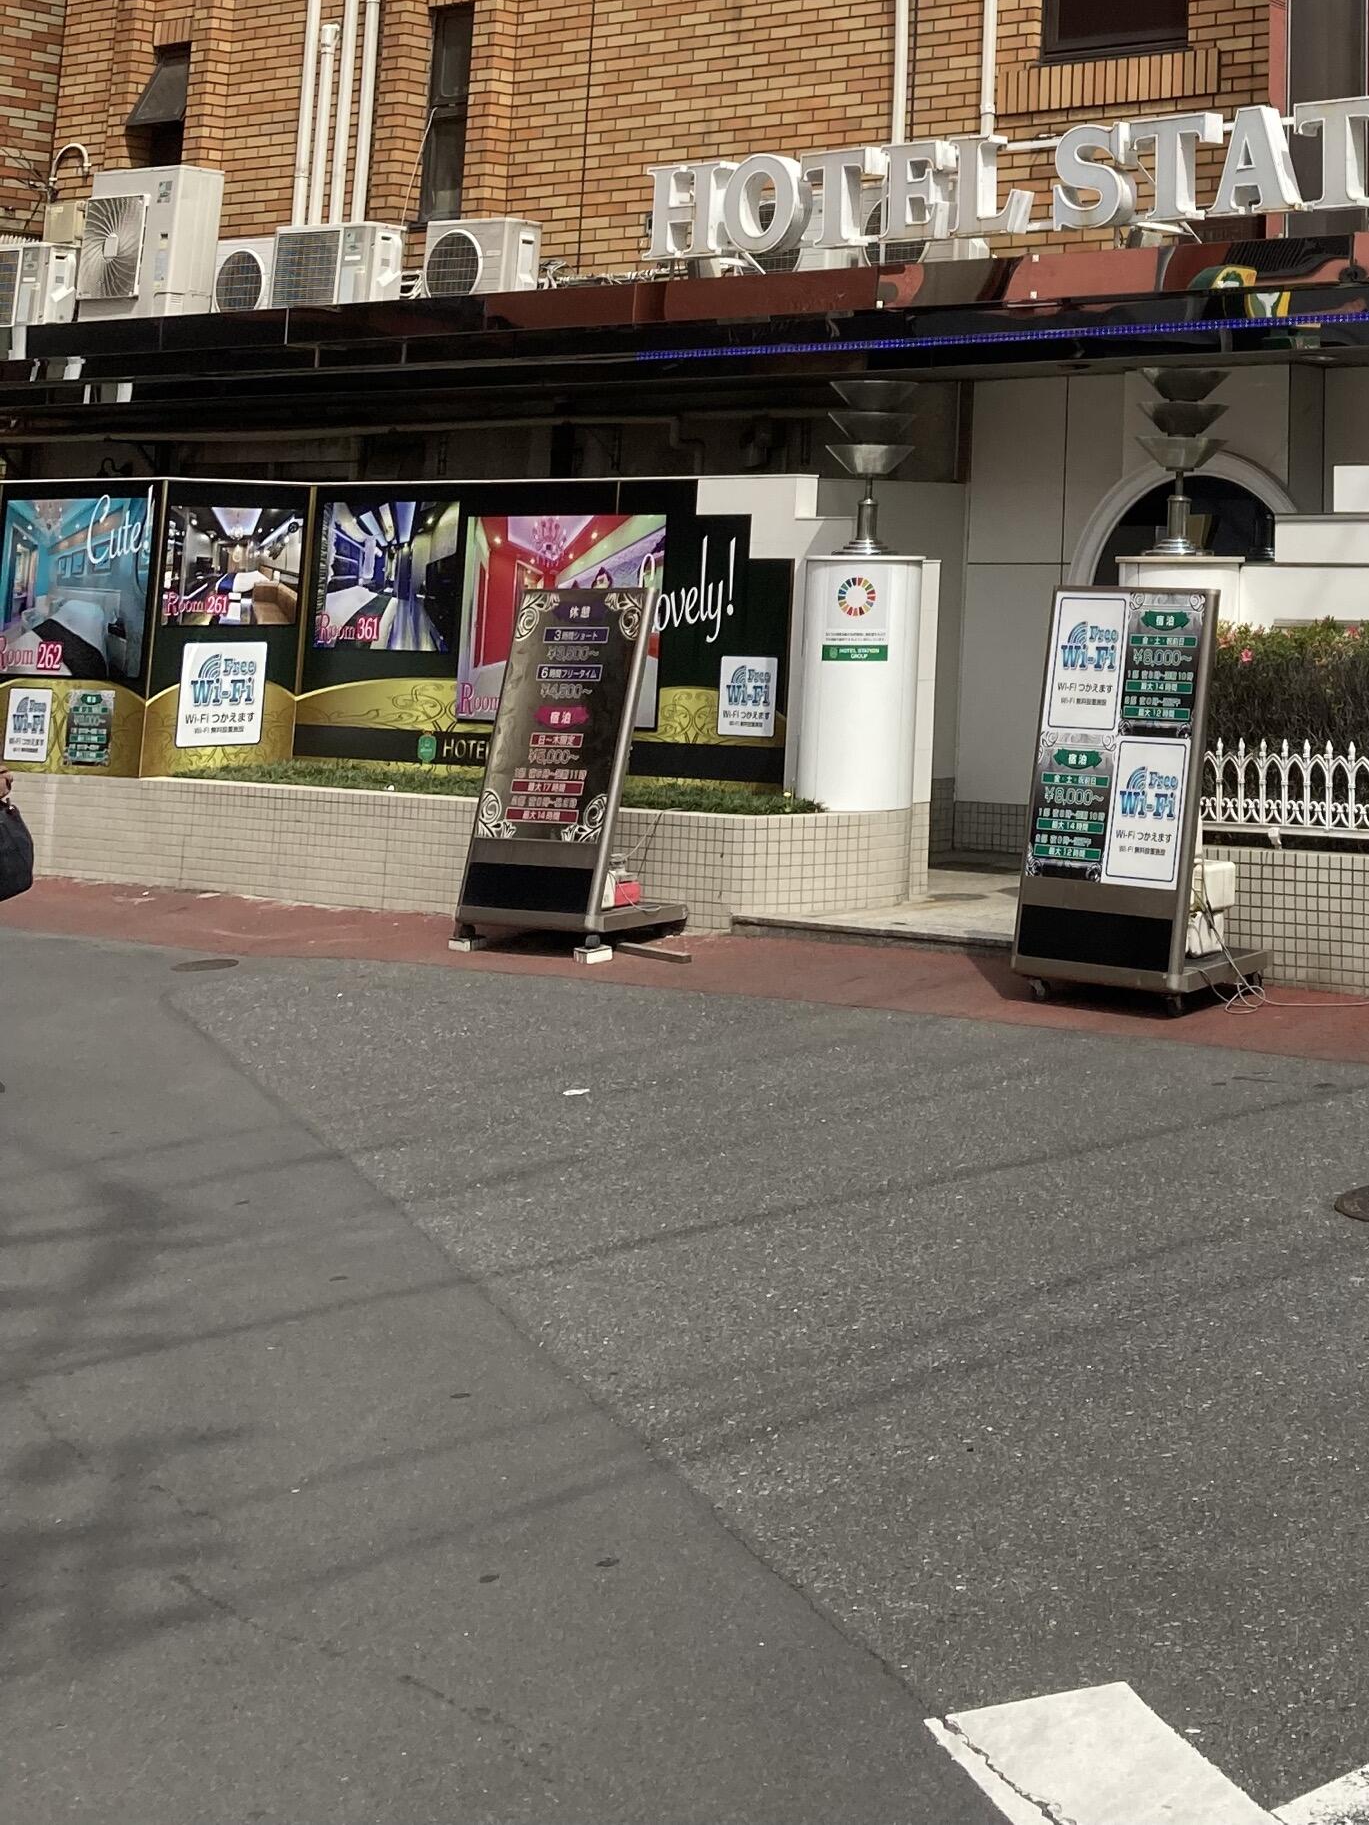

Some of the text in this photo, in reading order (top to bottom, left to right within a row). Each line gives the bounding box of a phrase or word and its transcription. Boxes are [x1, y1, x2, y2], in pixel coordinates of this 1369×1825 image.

[642, 134, 1035, 261] HOTEL
[87, 485, 154, 565] Cute!
[165, 593, 229, 616] Room 261
[317, 613, 379, 644] Room 361
[1088, 625, 1119, 643] Free
[0, 637, 62, 671] Room 262
[1061, 643, 1117, 672] Wi-Fi
[222, 658, 257, 676] Free
[747, 668, 771, 683] Free
[190, 677, 255, 707] Wi-Fi
[725, 683, 770, 707] Wi-Fi
[1057, 682, 1113, 693] Wi-Fi つかえます
[184, 712, 254, 724] Wi-Fi つかえます
[550, 711, 572, 724] 宿泊
[1148, 771, 1179, 790] Free
[1119, 790, 1176, 821] Wi-Fi
[1115, 829, 1172, 843] Wi-Fi つかえます
